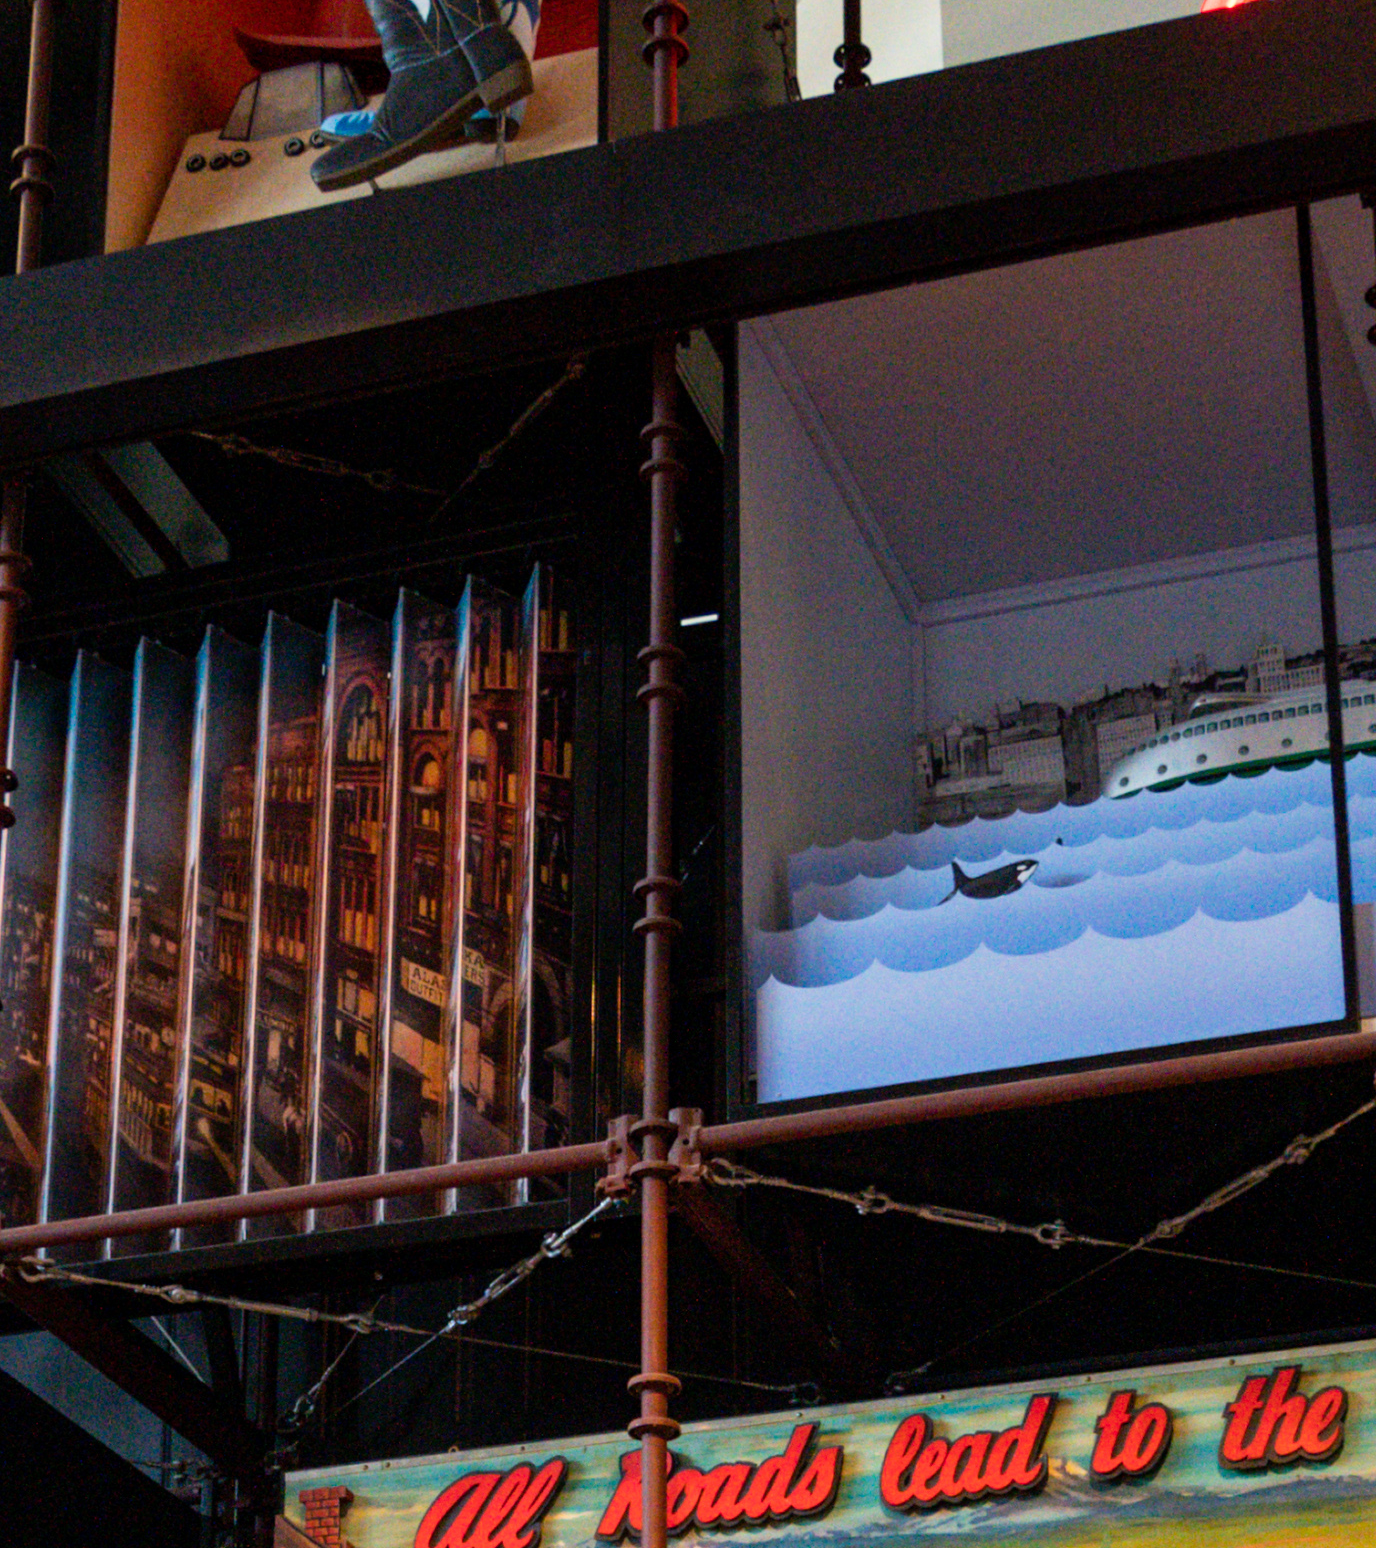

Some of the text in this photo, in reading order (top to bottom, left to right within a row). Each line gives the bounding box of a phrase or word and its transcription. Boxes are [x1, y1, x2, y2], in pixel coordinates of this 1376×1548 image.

[880, 1392, 1059, 1511] lead
[1090, 1389, 1172, 1480] to
[1219, 1365, 1347, 1469] the
